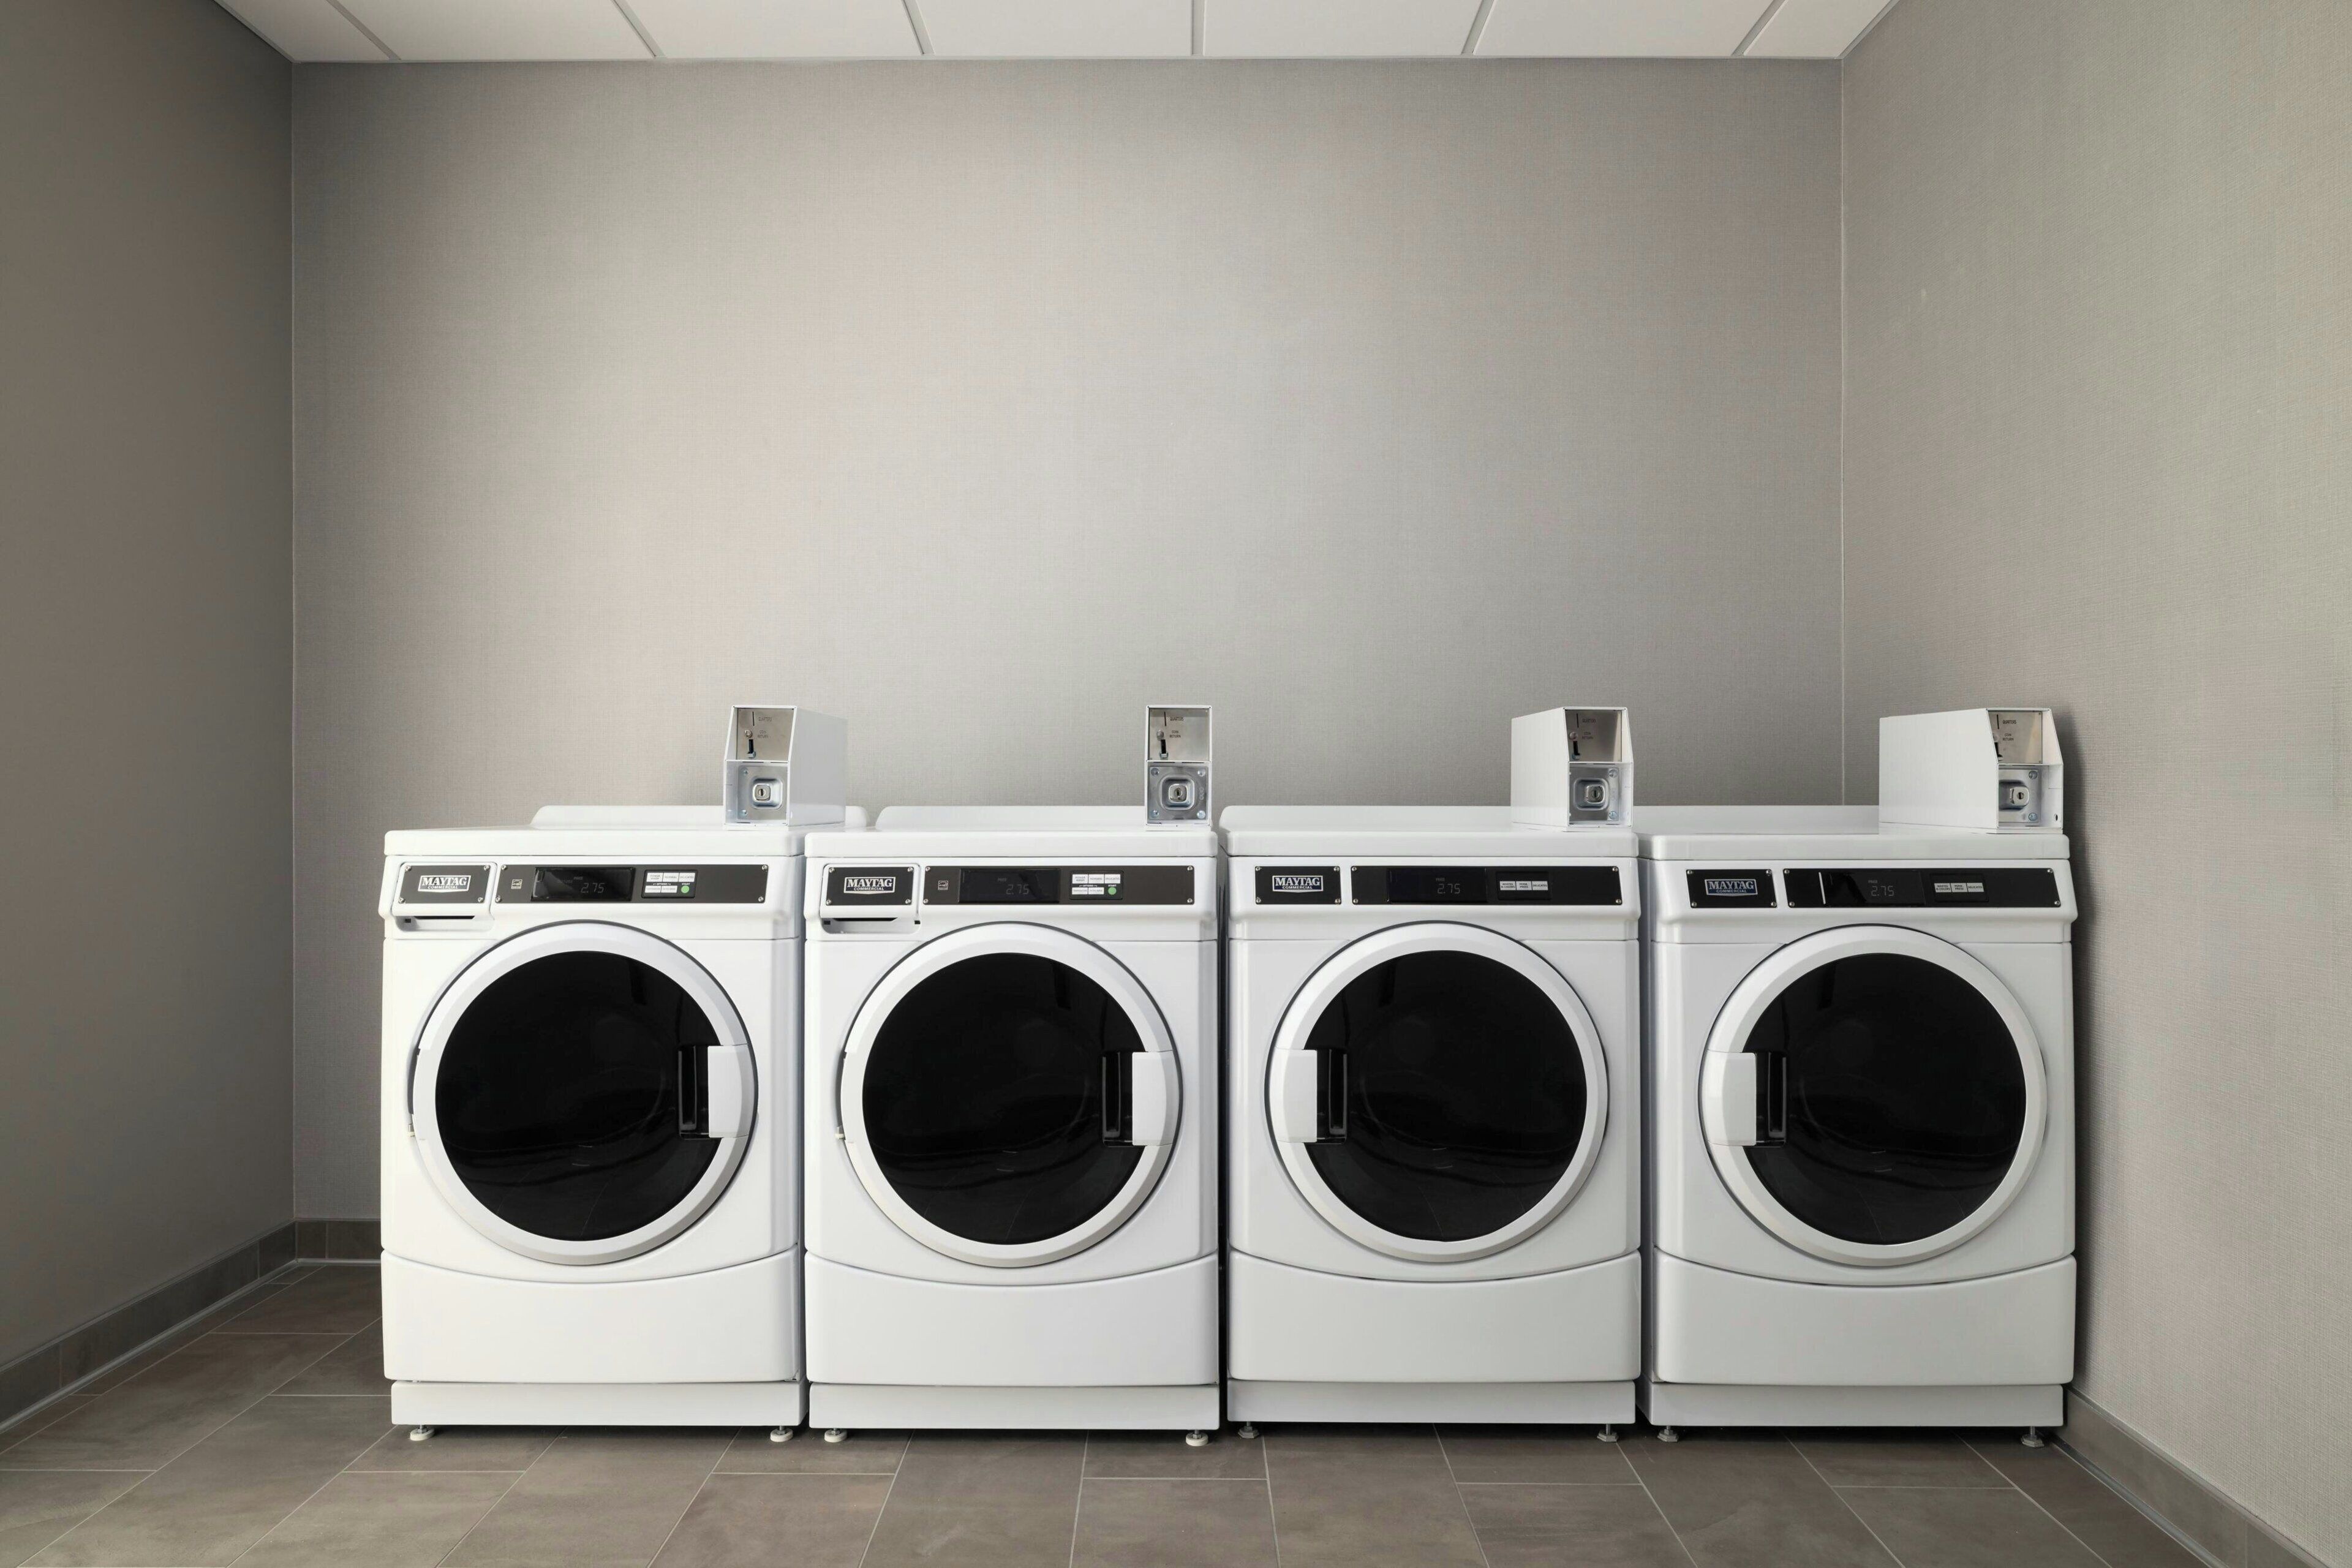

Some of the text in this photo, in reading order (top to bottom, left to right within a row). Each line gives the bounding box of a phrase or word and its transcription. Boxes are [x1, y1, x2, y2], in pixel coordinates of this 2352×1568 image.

[422, 877, 467, 886] MAYTAG
[581, 882, 605, 893] 2.75
[1006, 884, 1030, 895] 2.75
[1437, 883, 1461, 894] 2.75
[1871, 885, 1894, 896] 2.75
